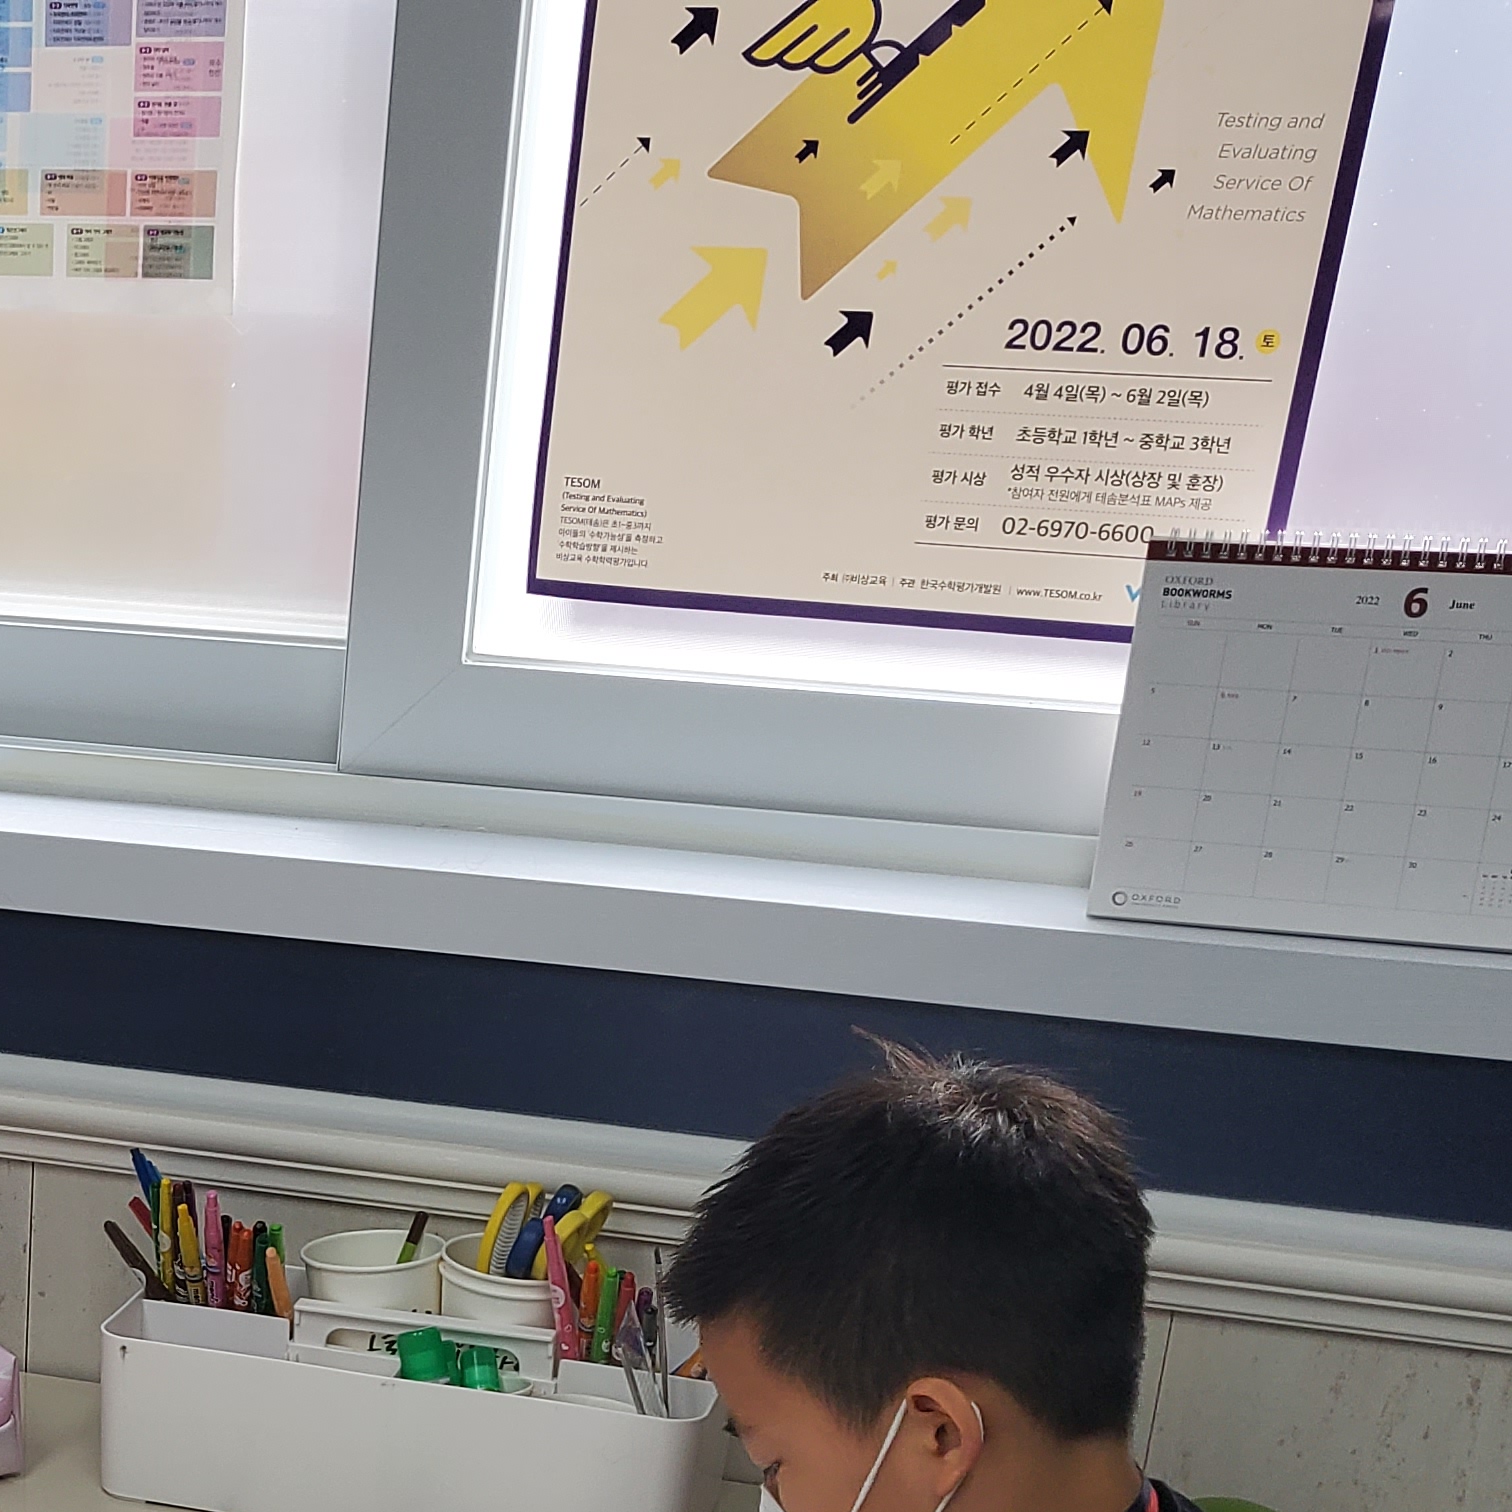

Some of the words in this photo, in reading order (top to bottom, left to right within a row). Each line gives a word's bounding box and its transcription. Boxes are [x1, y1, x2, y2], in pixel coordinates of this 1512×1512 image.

[1217, 112, 1283, 132] Testing
[1287, 113, 1326, 129] and
[1218, 143, 1317, 163] Evaluating
[1213, 174, 1282, 190] Service
[1288, 175, 1314, 192] Of
[1187, 204, 1306, 223] Mathematics
[1004, 318, 1106, 354] 2022.
[1121, 322, 1175, 358] 06.
[1193, 326, 1245, 361] 18.
[1260, 333, 1275, 348] 토
[945, 380, 972, 396] 평가
[975, 381, 1002, 397] 접수
[1023, 383, 1050, 400] 4월
[1053, 384, 1107, 404] 4일(목)
[1126, 388, 1153, 406] 6월
[1156, 389, 1210, 409] 2일(목)
[938, 423, 965, 439] 평가
[968, 424, 993, 440] 학년
[1016, 426, 1078, 445] 초등학교
[1082, 430, 1119, 449] 1학년
[1139, 432, 1186, 451] 중학교
[1190, 435, 1231, 455] 3학년
[564, 476, 601, 489] TESOM
[931, 470, 958, 485] 평가
[960, 471, 987, 487] 시상
[1010, 464, 1041, 482] 성적
[1044, 465, 1090, 486] 우수자
[1095, 468, 1163, 489] 시상(상장
[1167, 472, 1182, 489] 및
[1185, 473, 1225, 493] 훈장)
[562, 491, 590, 502] (Testing
[591, 494, 605, 502] and
[607, 495, 645, 506] Evaluating
[1048, 489, 1093, 503] 전원에게
[1155, 496, 1186, 508] MAPs
[1188, 498, 1213, 511] 제공
[561, 504, 586, 513] Service
[588, 506, 597, 514] Of
[598, 506, 647, 518] Mathematics)
[925, 514, 951, 530] 평가
[953, 516, 979, 532] 문의
[1001, 517, 1154, 544] 02-6970-6600
[1165, 575, 1214, 586] OXFORD
[1016, 587, 1103, 602] www.TESOM.co.kr
[1162, 587, 1232, 600] BOOKWORMS
[1355, 595, 1380, 606] 2022
[1403, 587, 1429, 619] 6
[1449, 599, 1476, 610] June
[1355, 752, 1363, 760] 15
[1131, 894, 1181, 904] OXFORD
